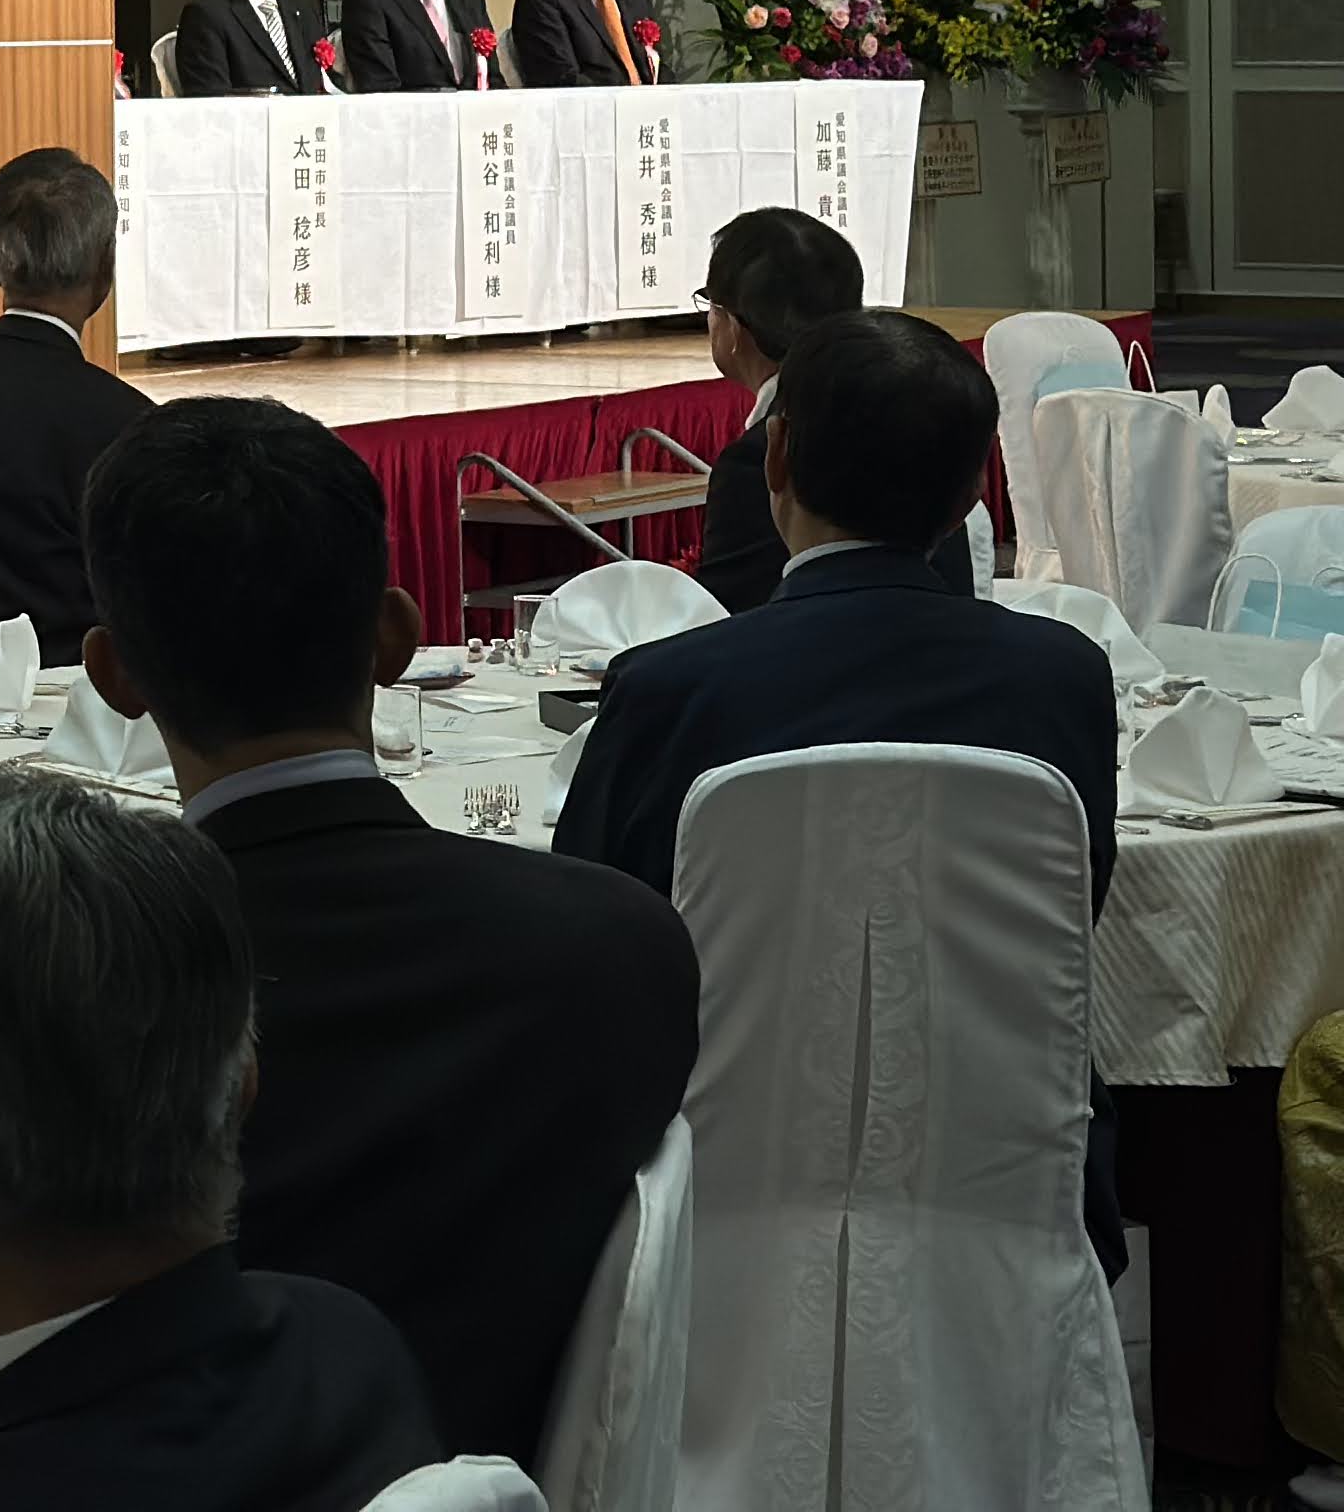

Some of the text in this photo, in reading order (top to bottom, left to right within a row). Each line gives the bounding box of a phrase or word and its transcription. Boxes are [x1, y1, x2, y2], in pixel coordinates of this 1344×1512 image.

[293, 134, 312, 191] 太田
[314, 126, 327, 229] 豊田市市長
[482, 131, 499, 186] 神谷
[637, 124, 656, 179] 桜井
